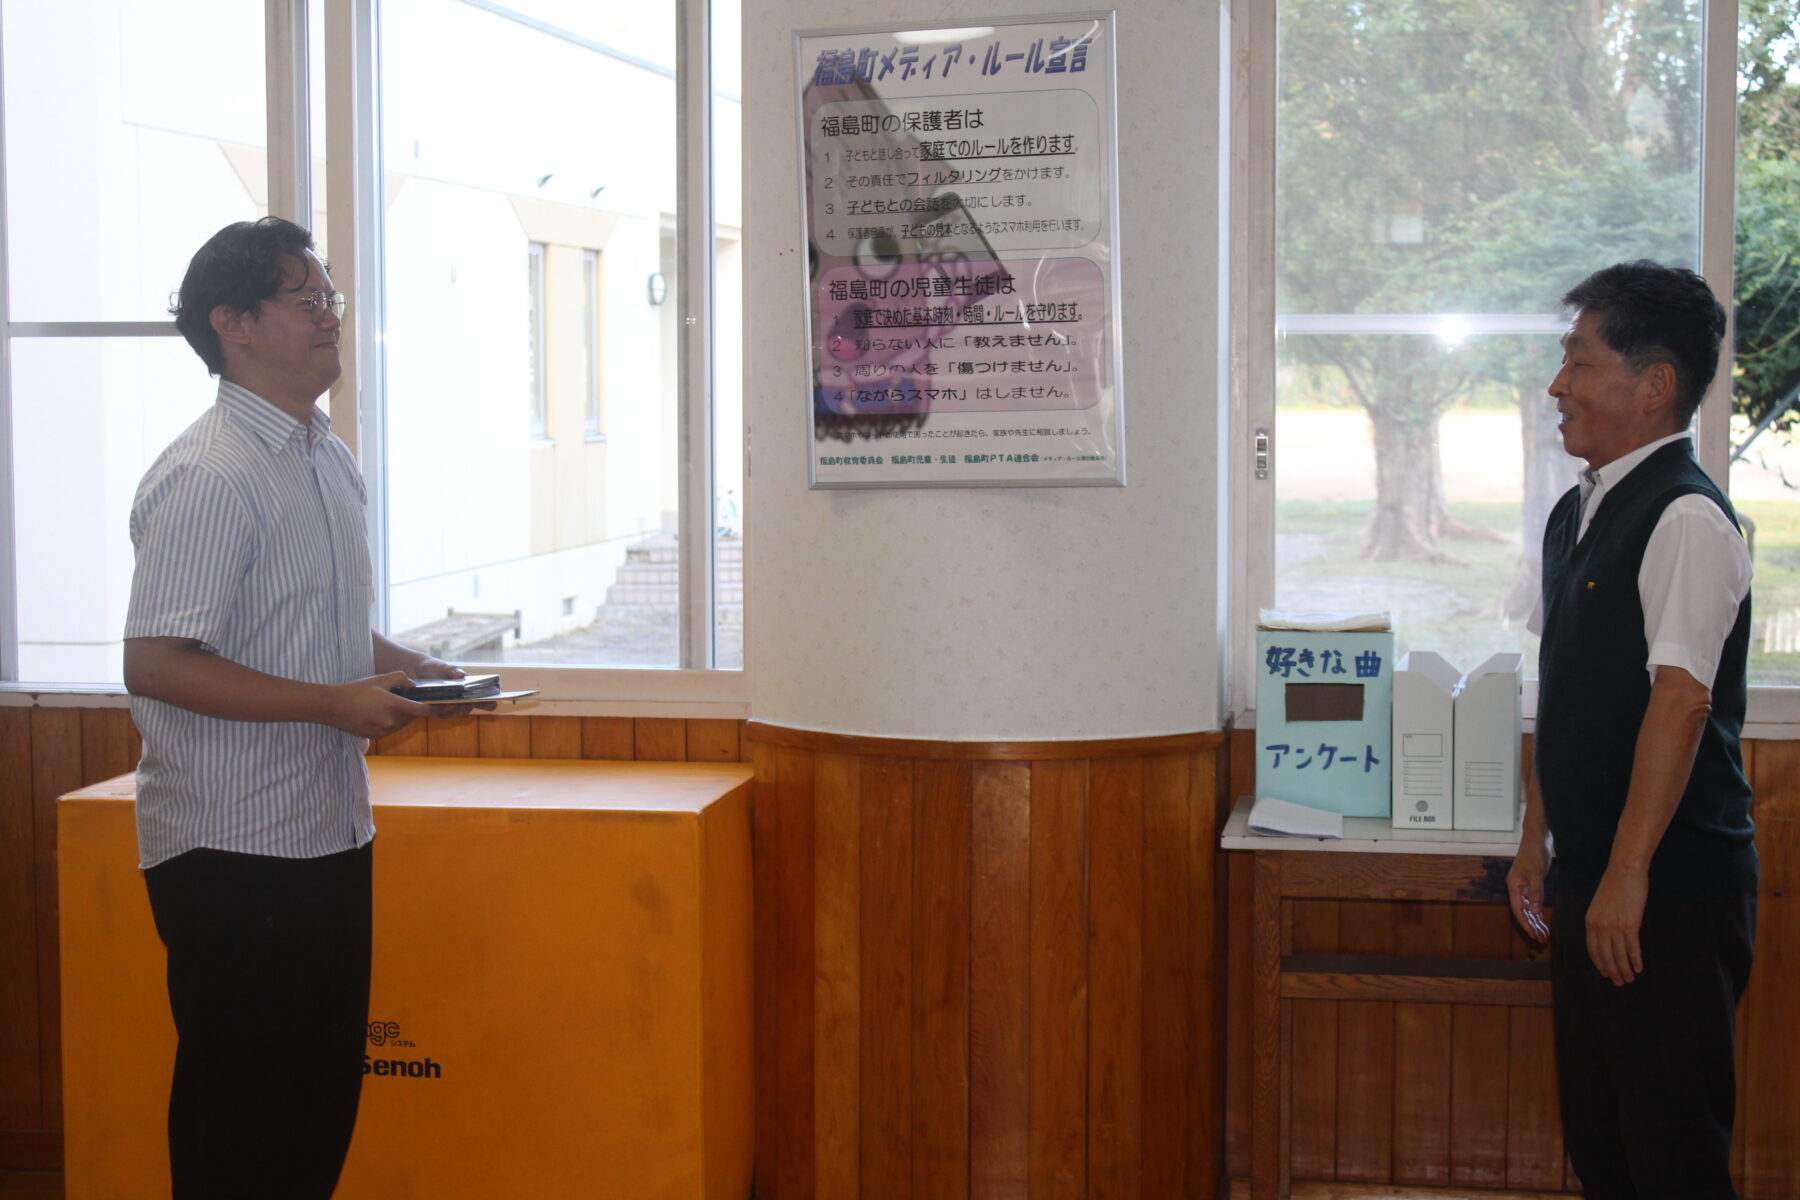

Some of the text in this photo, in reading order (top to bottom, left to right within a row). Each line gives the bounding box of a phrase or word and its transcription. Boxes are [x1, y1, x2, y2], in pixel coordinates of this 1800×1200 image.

[815, 36, 1093, 86] 福島町メディア・ルール宣言
[821, 108, 984, 137] 福島町の保護者は
[824, 152, 831, 162] 1
[824, 166, 1070, 189] 2 その責任でフィルタリングをかけます。
[825, 203, 834, 215] 3
[826, 229, 835, 240] 4
[829, 274, 1016, 301] 福島町の児童生徒は
[832, 333, 1077, 352] 2 知らない人に「教えません」。
[832, 359, 1078, 377] 3 周りの人を「傷つけません」。
[834, 385, 1070, 403] 4 「ながらスマホ」はしません。
[820, 456, 884, 465] 福島町教育委員会
[891, 455, 957, 465] 福島町児童・生徒
[1266, 646, 1382, 678] 好きな曲
[1266, 743, 1380, 773] アンケート
[1409, 815, 1422, 823] FILE
[367, 1021, 401, 1047] gc
[360, 1055, 442, 1078] Senoh
